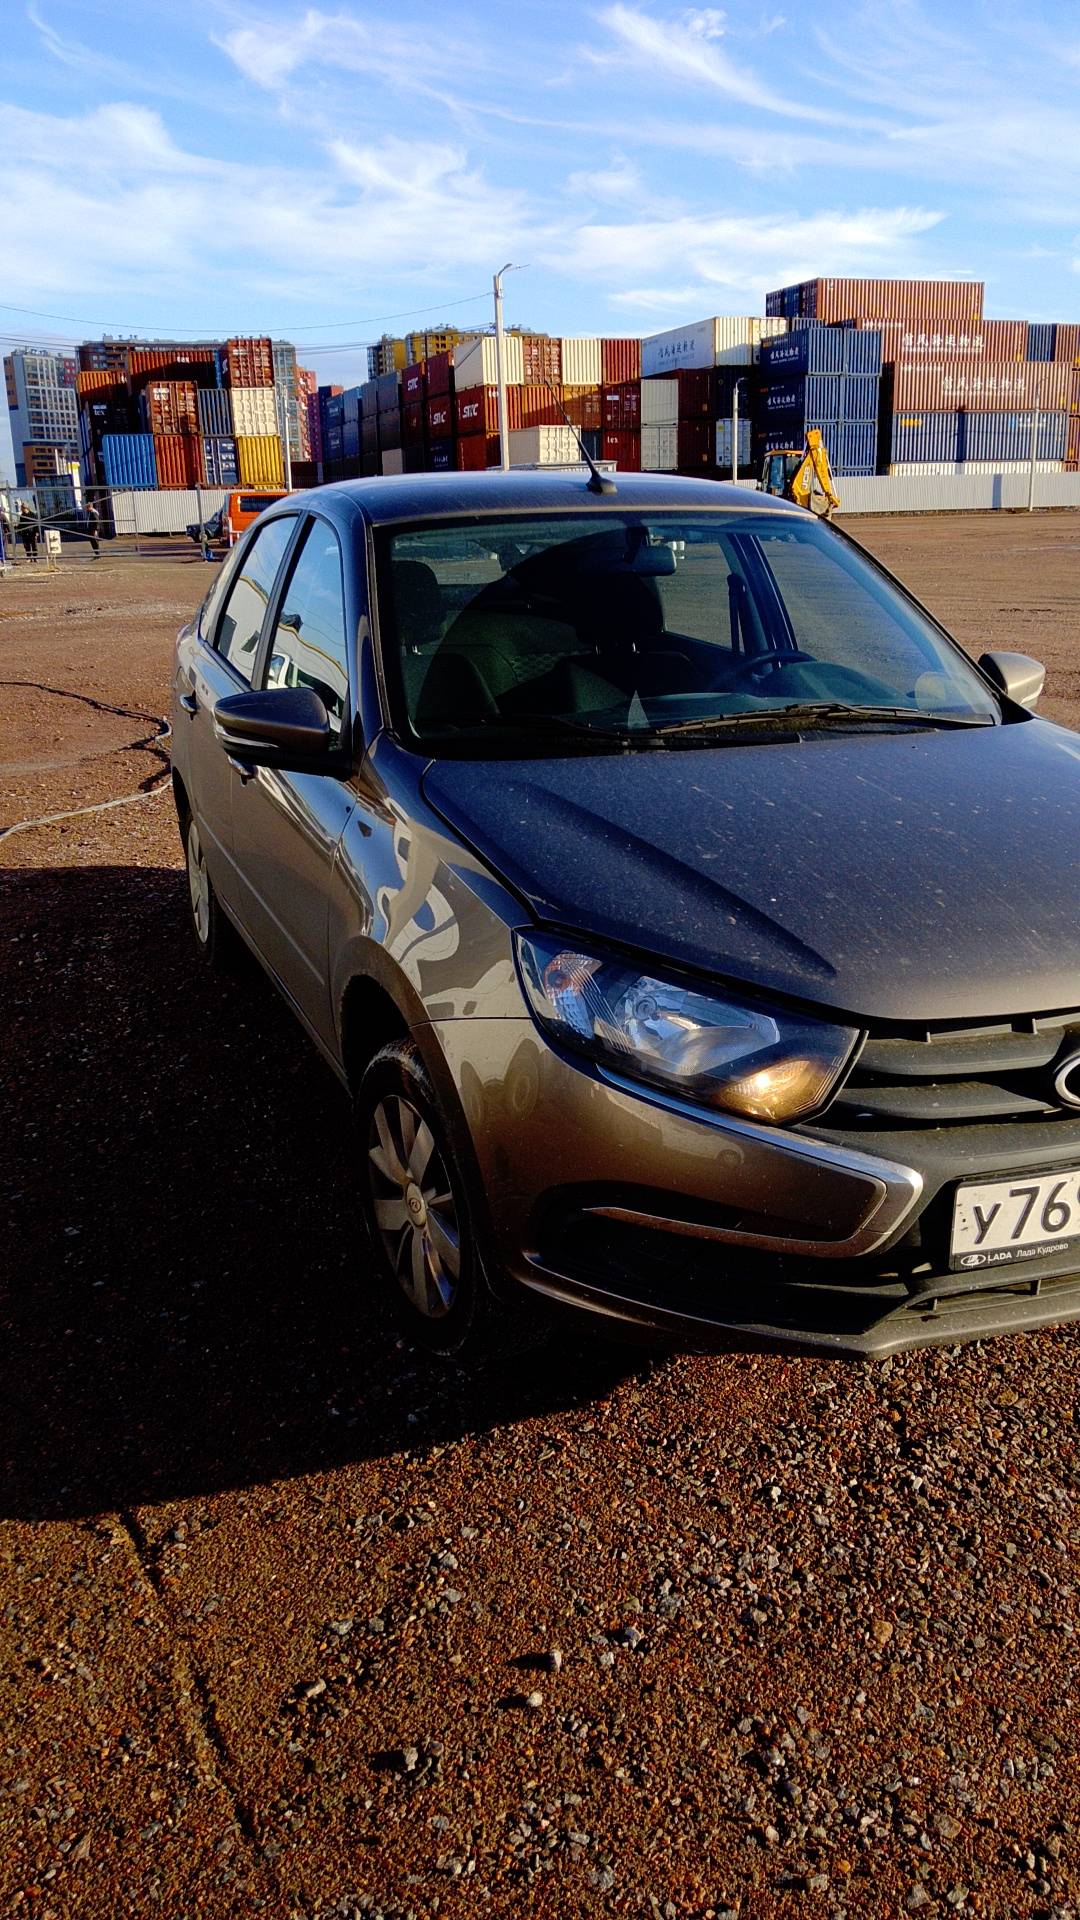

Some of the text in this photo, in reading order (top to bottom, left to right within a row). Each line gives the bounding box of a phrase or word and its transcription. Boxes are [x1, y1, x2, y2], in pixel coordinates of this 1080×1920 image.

[802, 466, 810, 490] JCB
[973, 1181, 1080, 1244] У76
[988, 1243, 1069, 1262] LADA Лада Кудрово
